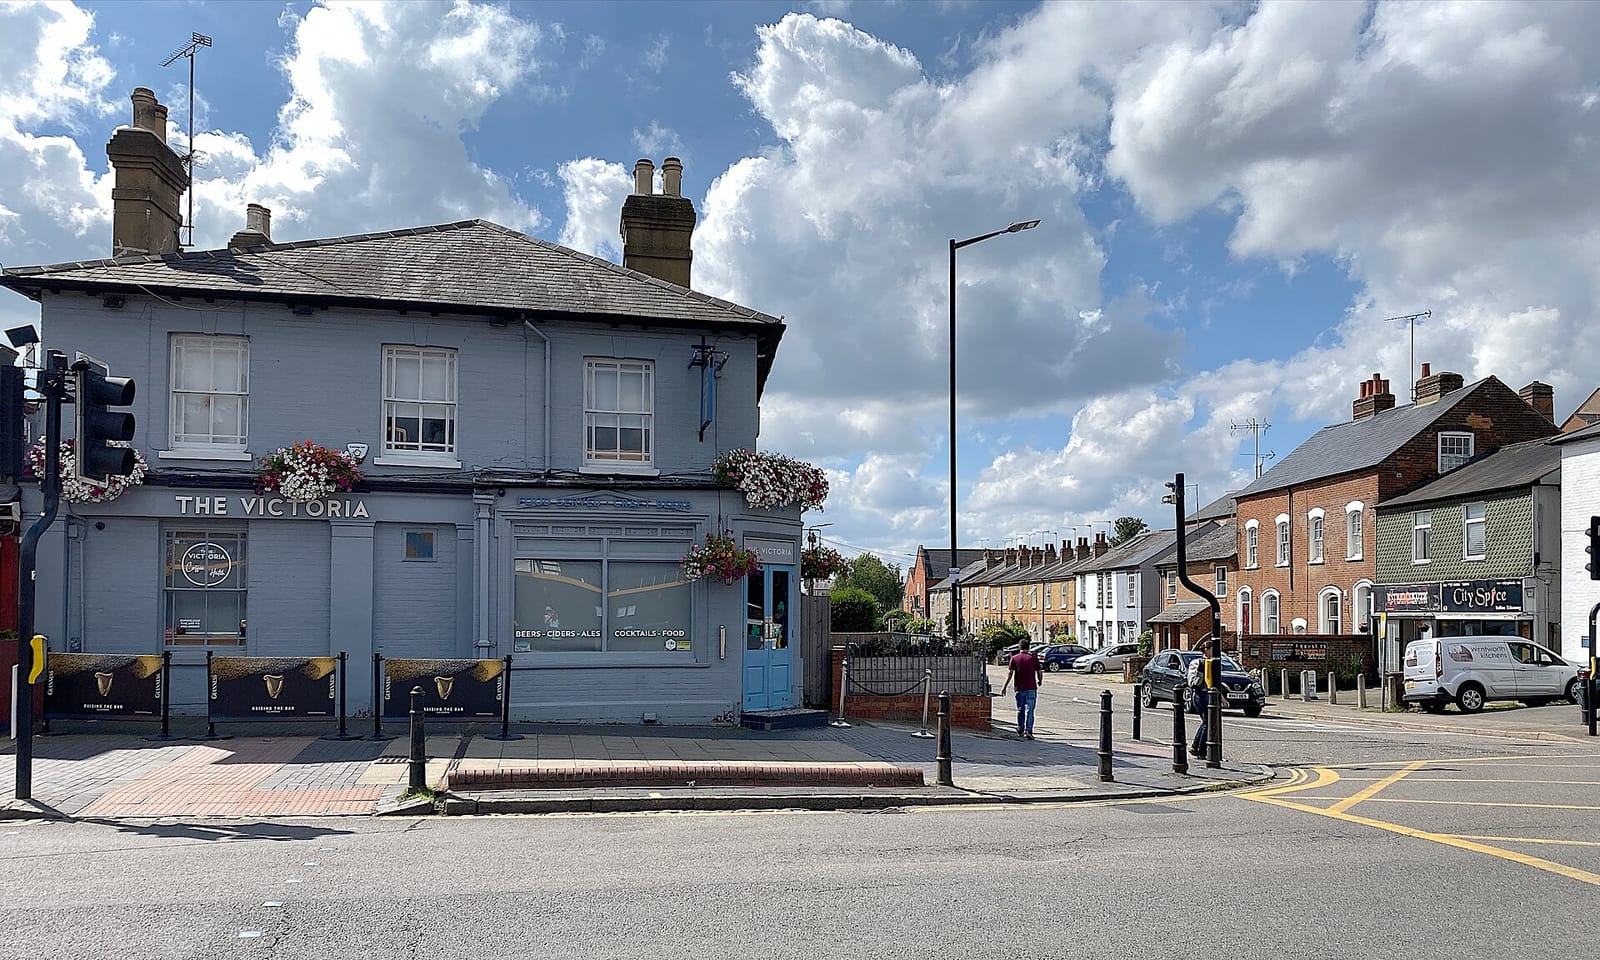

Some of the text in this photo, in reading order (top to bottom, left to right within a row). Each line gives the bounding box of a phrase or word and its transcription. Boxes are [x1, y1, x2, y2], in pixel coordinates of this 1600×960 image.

[517, 496, 551, 506] FOOD
[557, 498, 601, 507] SERVED
[175, 496, 369, 518] THE VICTORIA
[761, 547, 792, 556] VICTORIA
[1453, 586, 1507, 608] City Spice
[515, 630, 541, 638] BEERS
[547, 630, 575, 638] CIDERS
[580, 630, 601, 638] ALES
[614, 630, 657, 638] COCKTAILS
[662, 629, 685, 637] FOOD
